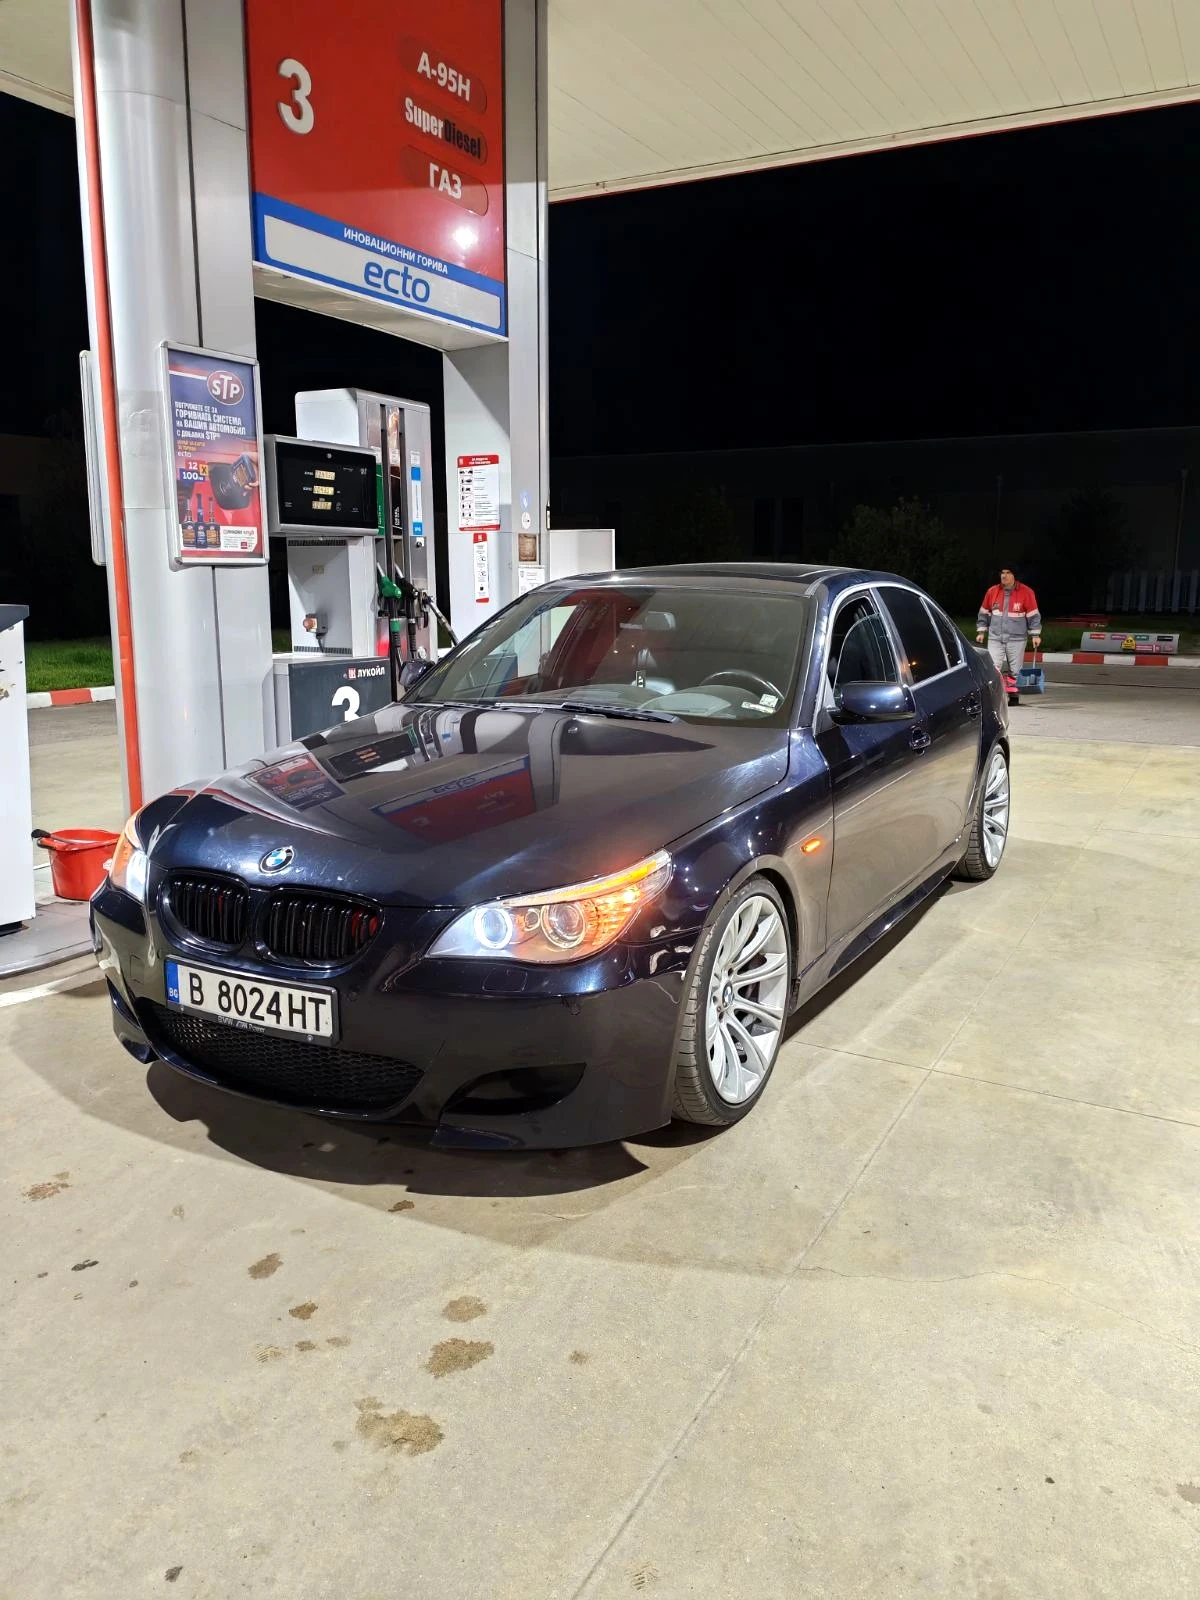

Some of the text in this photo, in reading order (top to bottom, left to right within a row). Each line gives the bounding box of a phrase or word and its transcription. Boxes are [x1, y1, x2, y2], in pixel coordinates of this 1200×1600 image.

[278, 58, 315, 135] 3
[429, 162, 462, 199] ГАЗ
[343, 227, 449, 275] ИНОВАЦИОННИ ГОРИВА
[363, 261, 430, 303] ecto
[211, 374, 241, 400] STP
[212, 413, 243, 426] СИСТЕМА
[357, 665, 385, 678] ЛУКОЙЛ
[189, 972, 204, 1006] B
